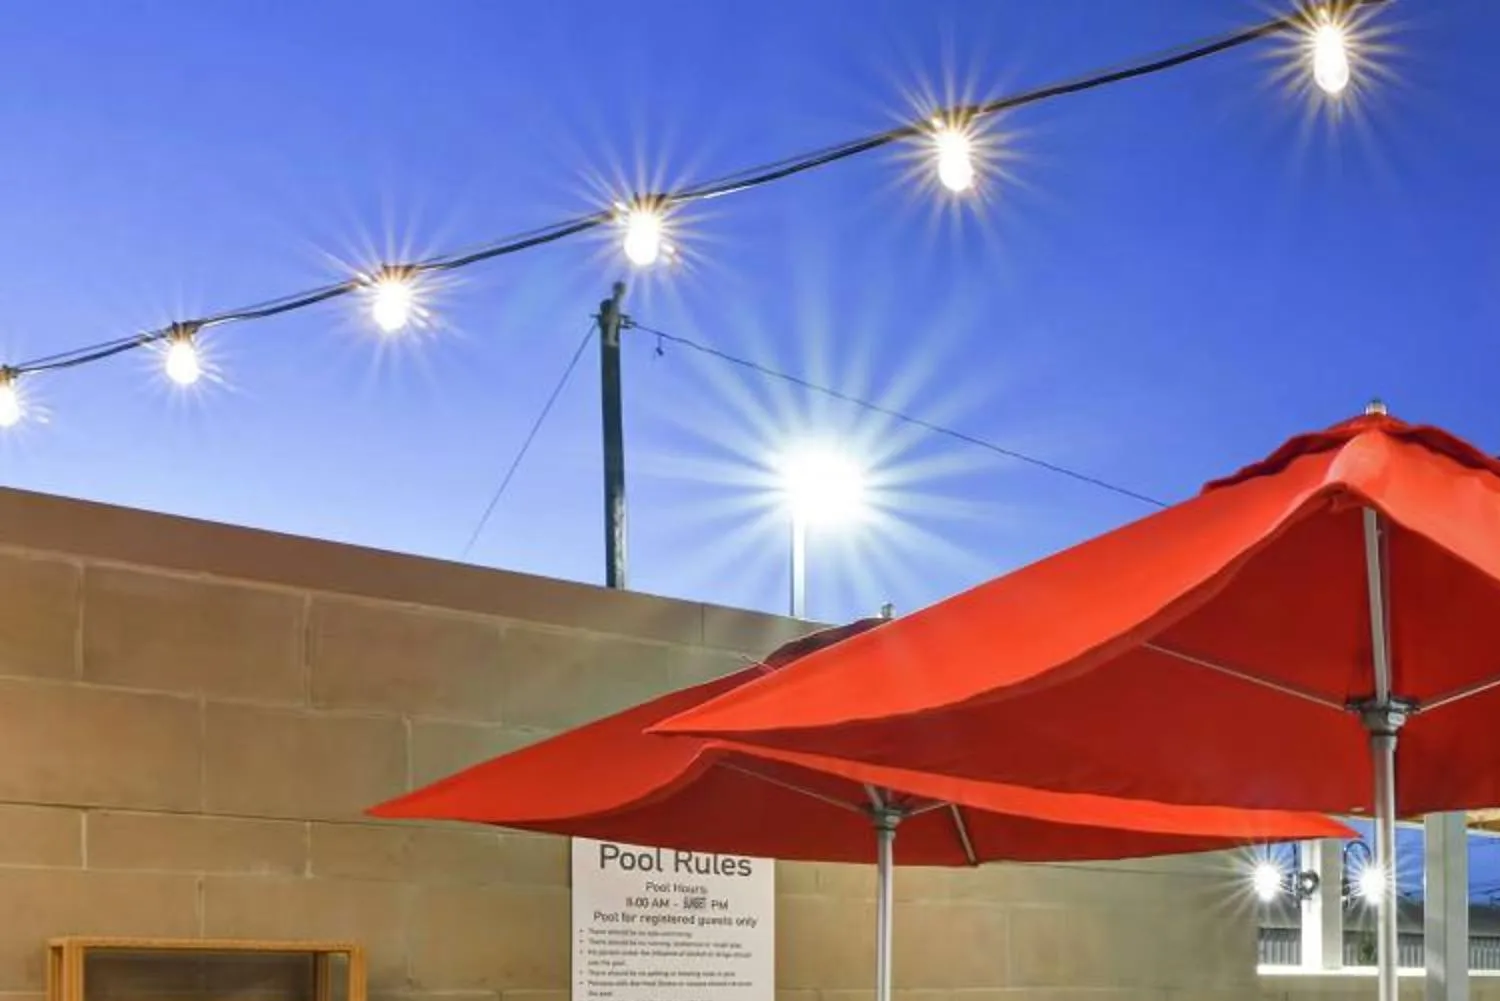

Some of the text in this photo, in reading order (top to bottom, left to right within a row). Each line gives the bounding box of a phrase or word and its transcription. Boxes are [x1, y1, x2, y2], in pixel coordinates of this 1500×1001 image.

[599, 844, 753, 877] Pool Rules
[645, 881, 671, 893] Pool
[651, 898, 670, 909] AM
[711, 899, 729, 911] PM
[593, 911, 620, 923] Pool
[622, 912, 636, 923] for
[639, 913, 695, 927] registered
[735, 916, 758, 929] only
